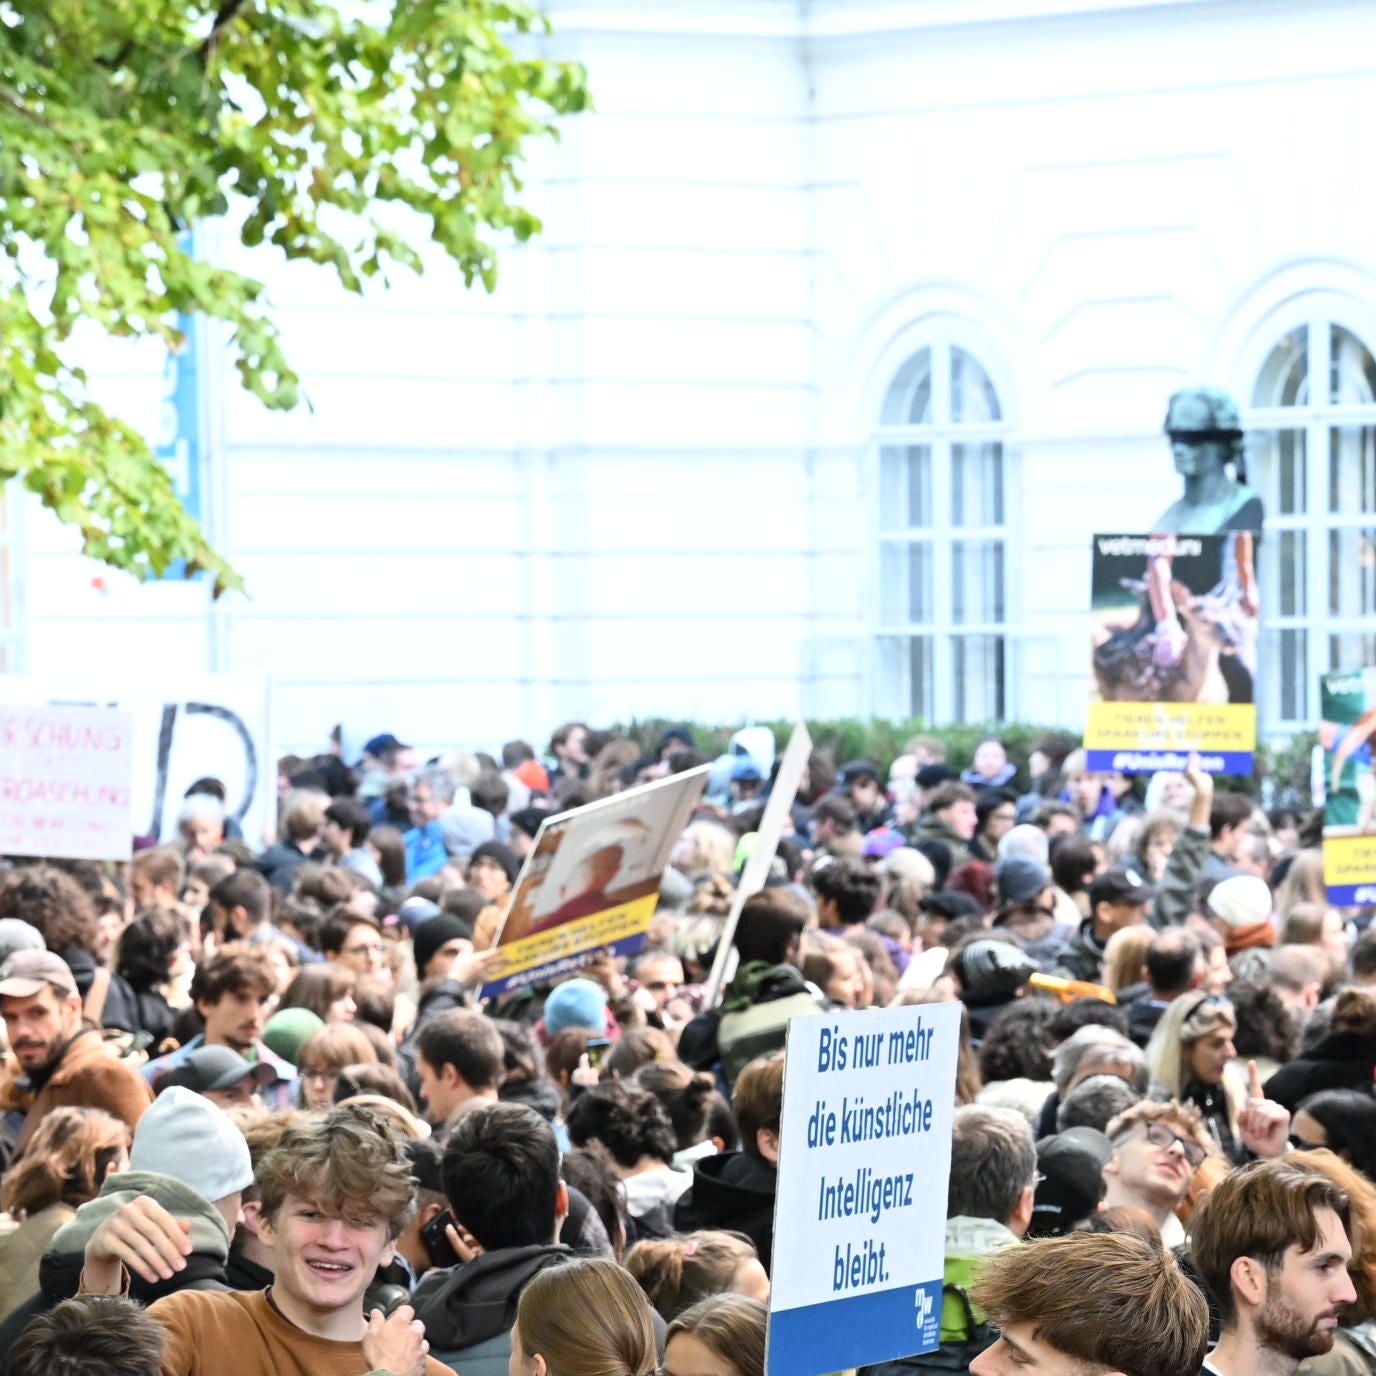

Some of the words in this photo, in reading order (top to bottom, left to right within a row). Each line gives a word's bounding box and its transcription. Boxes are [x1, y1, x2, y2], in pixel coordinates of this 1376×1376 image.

[817, 1025, 848, 1073] Bis
[852, 1032, 884, 1069] nur
[887, 1016, 934, 1065] mehr
[807, 1100, 836, 1149] die
[840, 1088, 933, 1145] künstliche
[818, 1167, 914, 1224] Intelligenz
[832, 1239, 889, 1292] bleibt.
